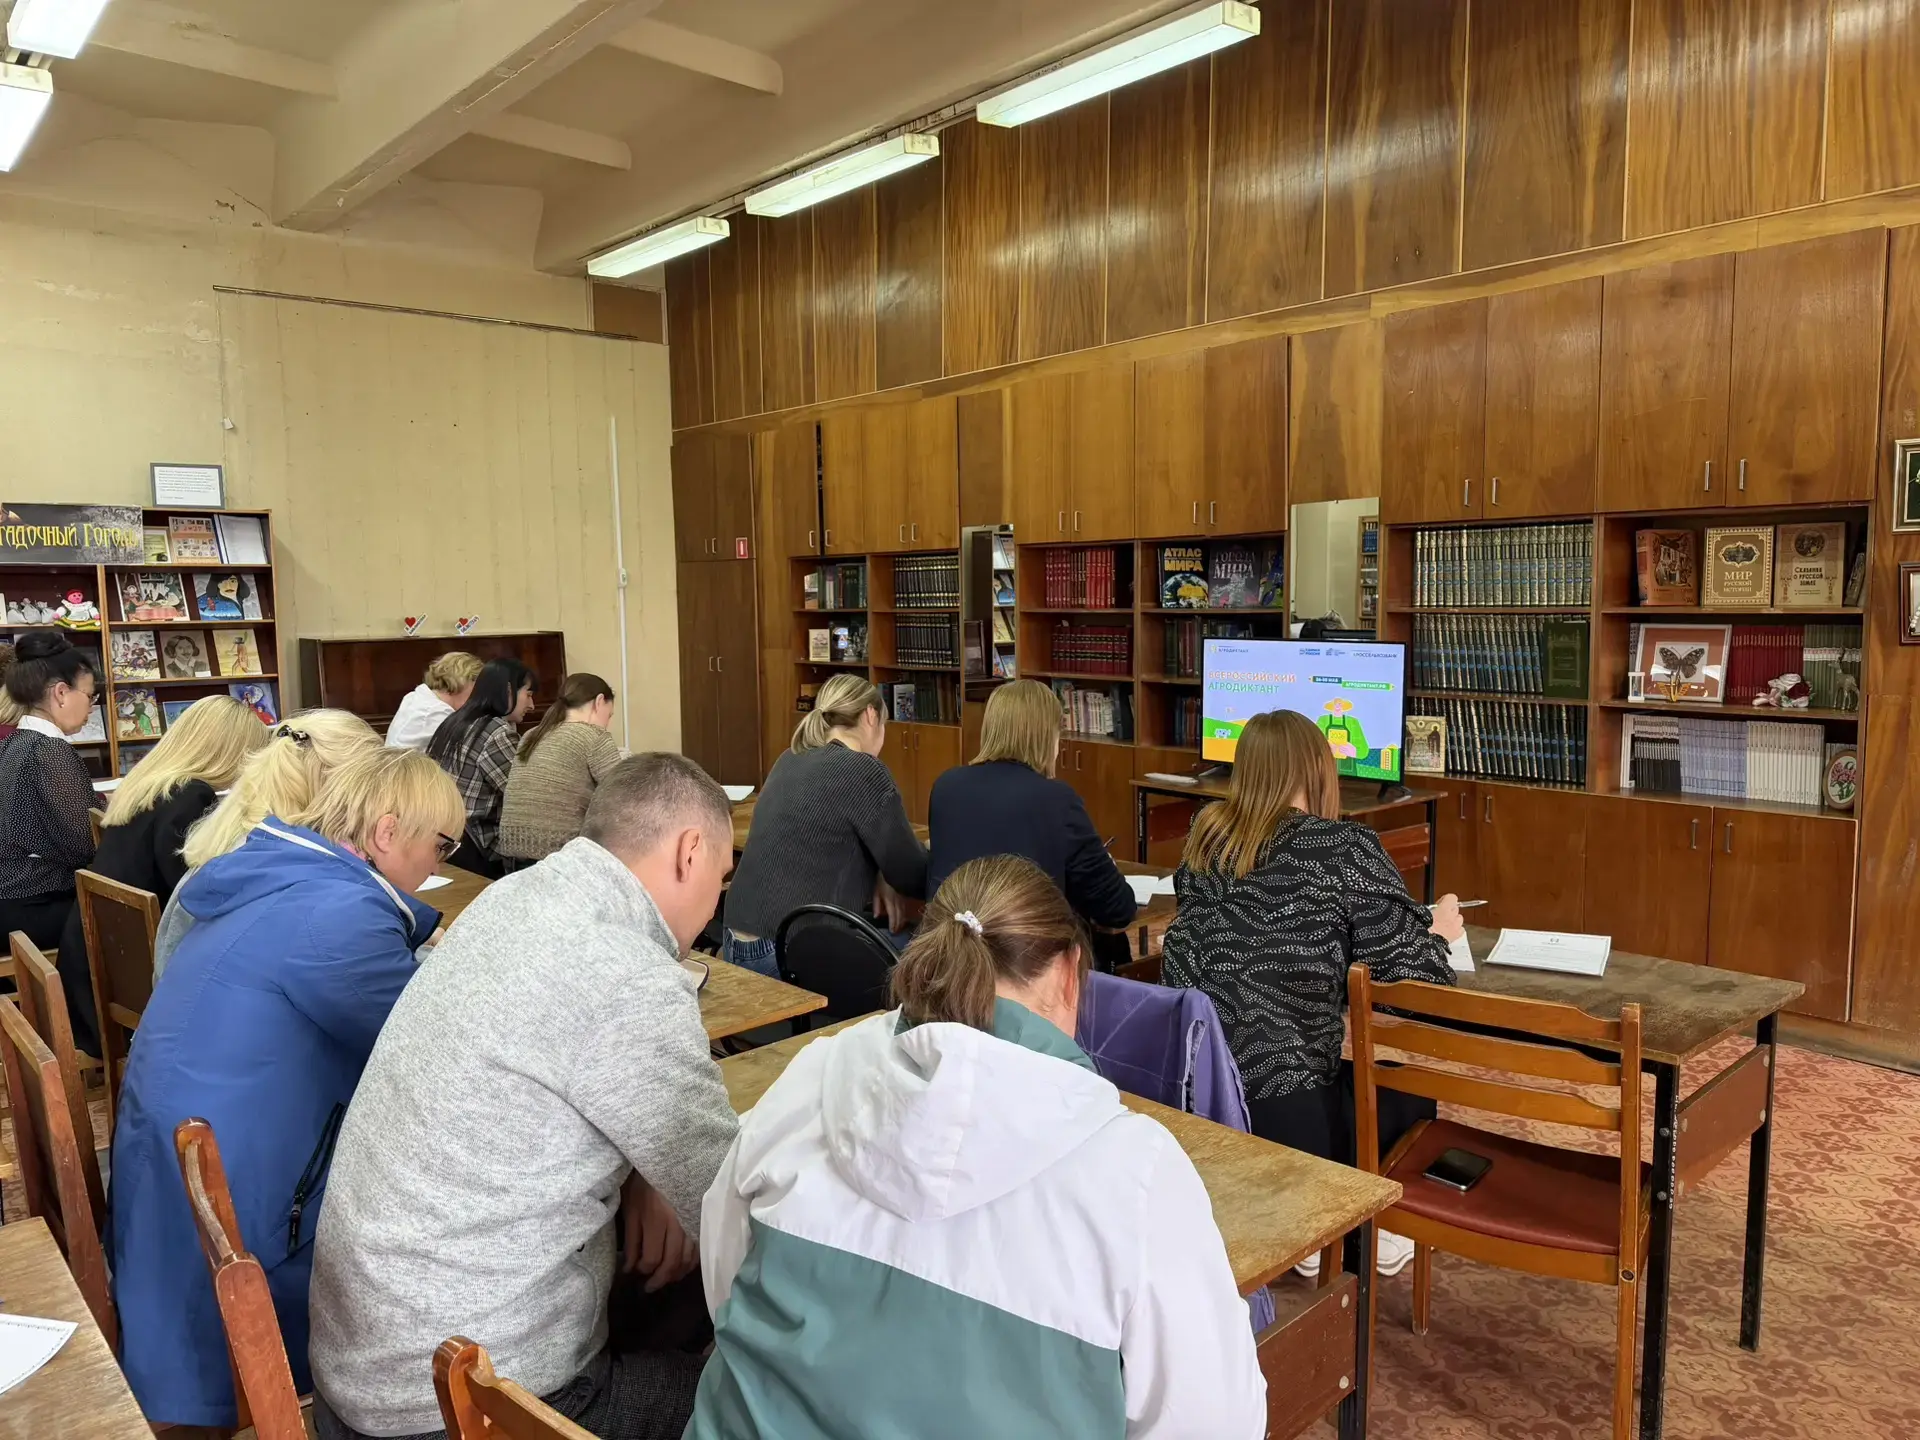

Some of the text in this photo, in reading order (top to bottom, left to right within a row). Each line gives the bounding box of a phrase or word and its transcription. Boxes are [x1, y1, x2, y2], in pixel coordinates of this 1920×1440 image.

[1164, 547, 1202, 557] АТЛАС
[1164, 559, 1204, 572] МИРА
[1213, 562, 1255, 579] МИРА
[1724, 571, 1753, 580] МИР
[1208, 670, 1296, 683] ВСЕРОССИЙСКИЙ
[1208, 682, 1280, 694] АГРОДИКТАНТ
